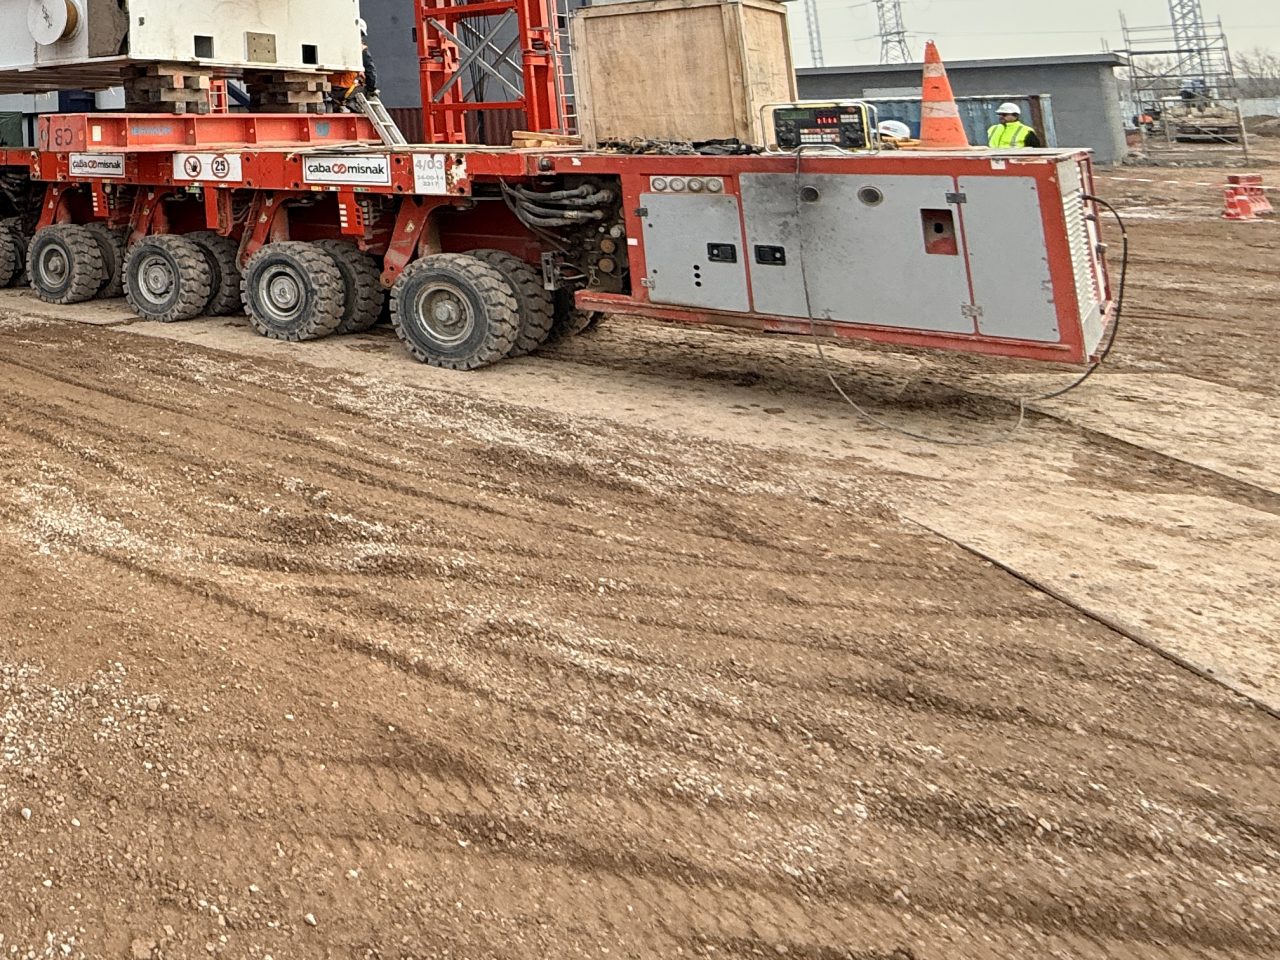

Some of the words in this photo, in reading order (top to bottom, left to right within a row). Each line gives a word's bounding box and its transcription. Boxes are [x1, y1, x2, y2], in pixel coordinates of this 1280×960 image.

[97, 159, 122, 170] misnak
[214, 160, 226, 171] 25
[307, 162, 332, 175] çaba
[347, 163, 385, 175] misnak
